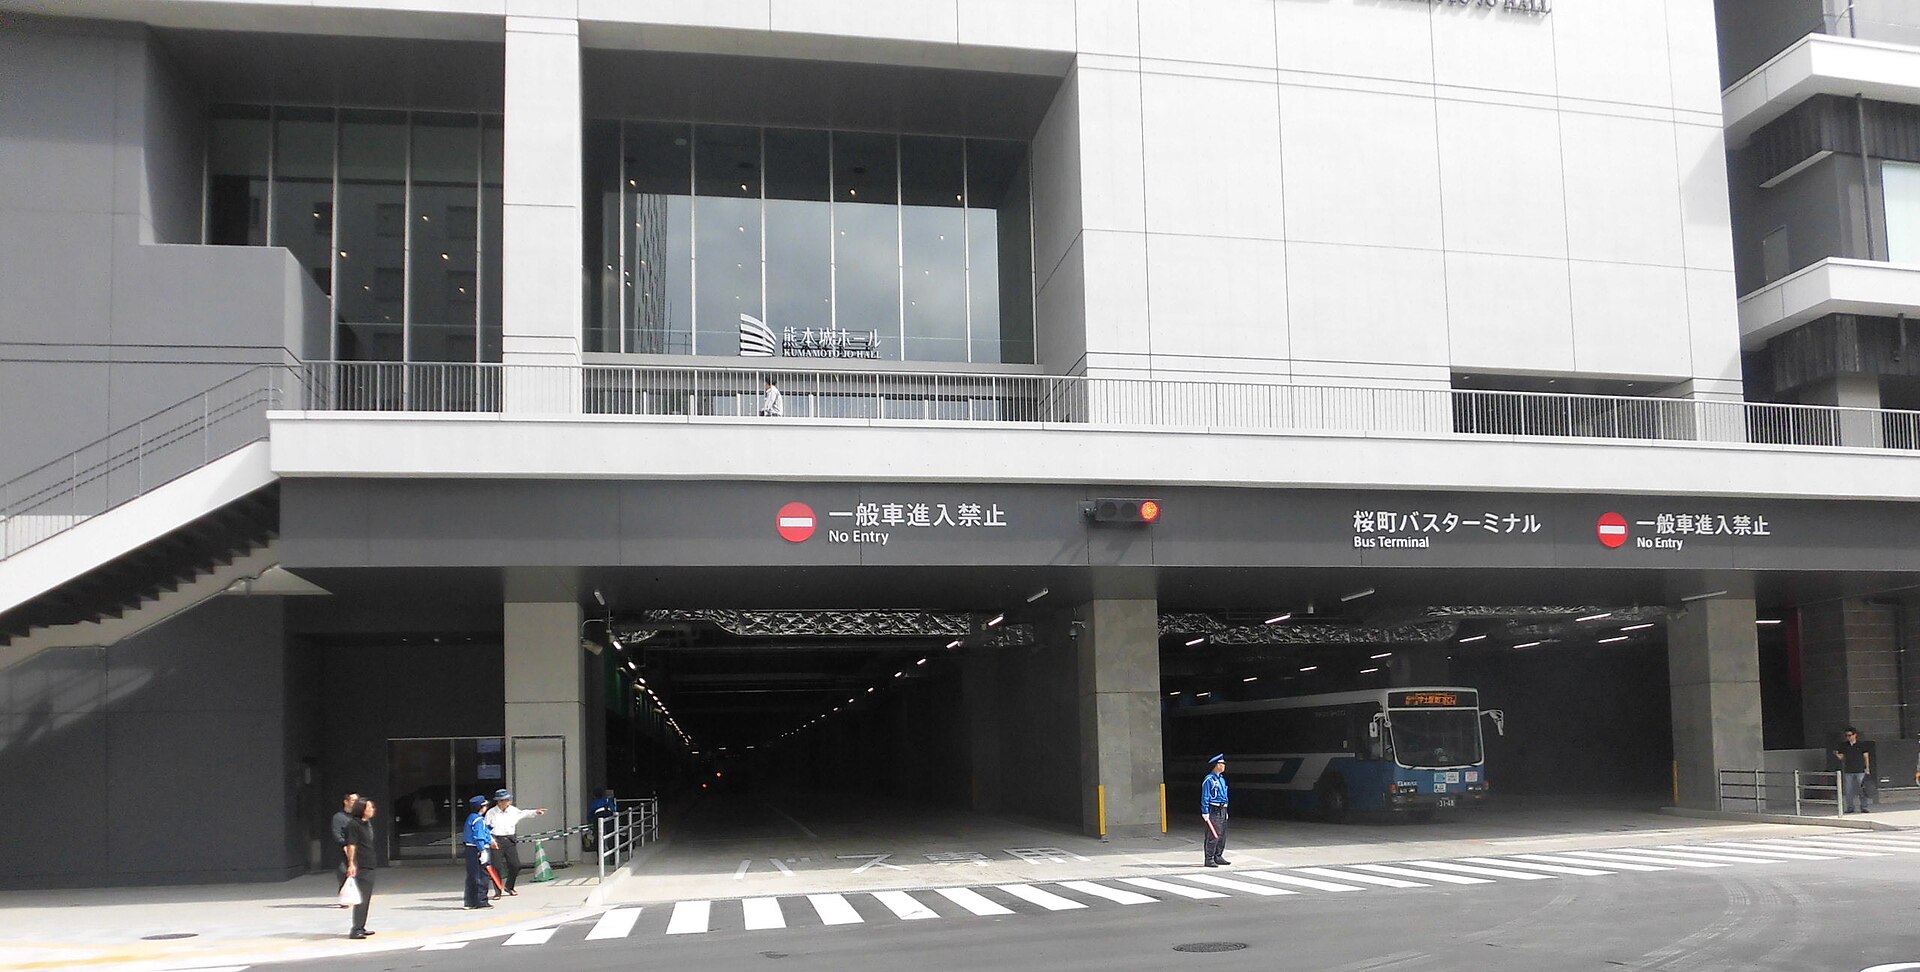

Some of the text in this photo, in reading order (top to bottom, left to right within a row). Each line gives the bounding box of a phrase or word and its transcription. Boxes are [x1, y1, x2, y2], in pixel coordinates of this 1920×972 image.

[784, 326, 882, 348] 熊本城ホール
[856, 351, 882, 359] HALL
[829, 503, 1007, 527] 一般車進入禁止
[1353, 511, 1541, 534] 桜町バスターミナル
[1636, 514, 1770, 536] 一般車進入禁止
[829, 530, 889, 546] No Entry
[1354, 536, 1429, 549] Bus Terminal
[1637, 537, 1683, 551] No Entry
